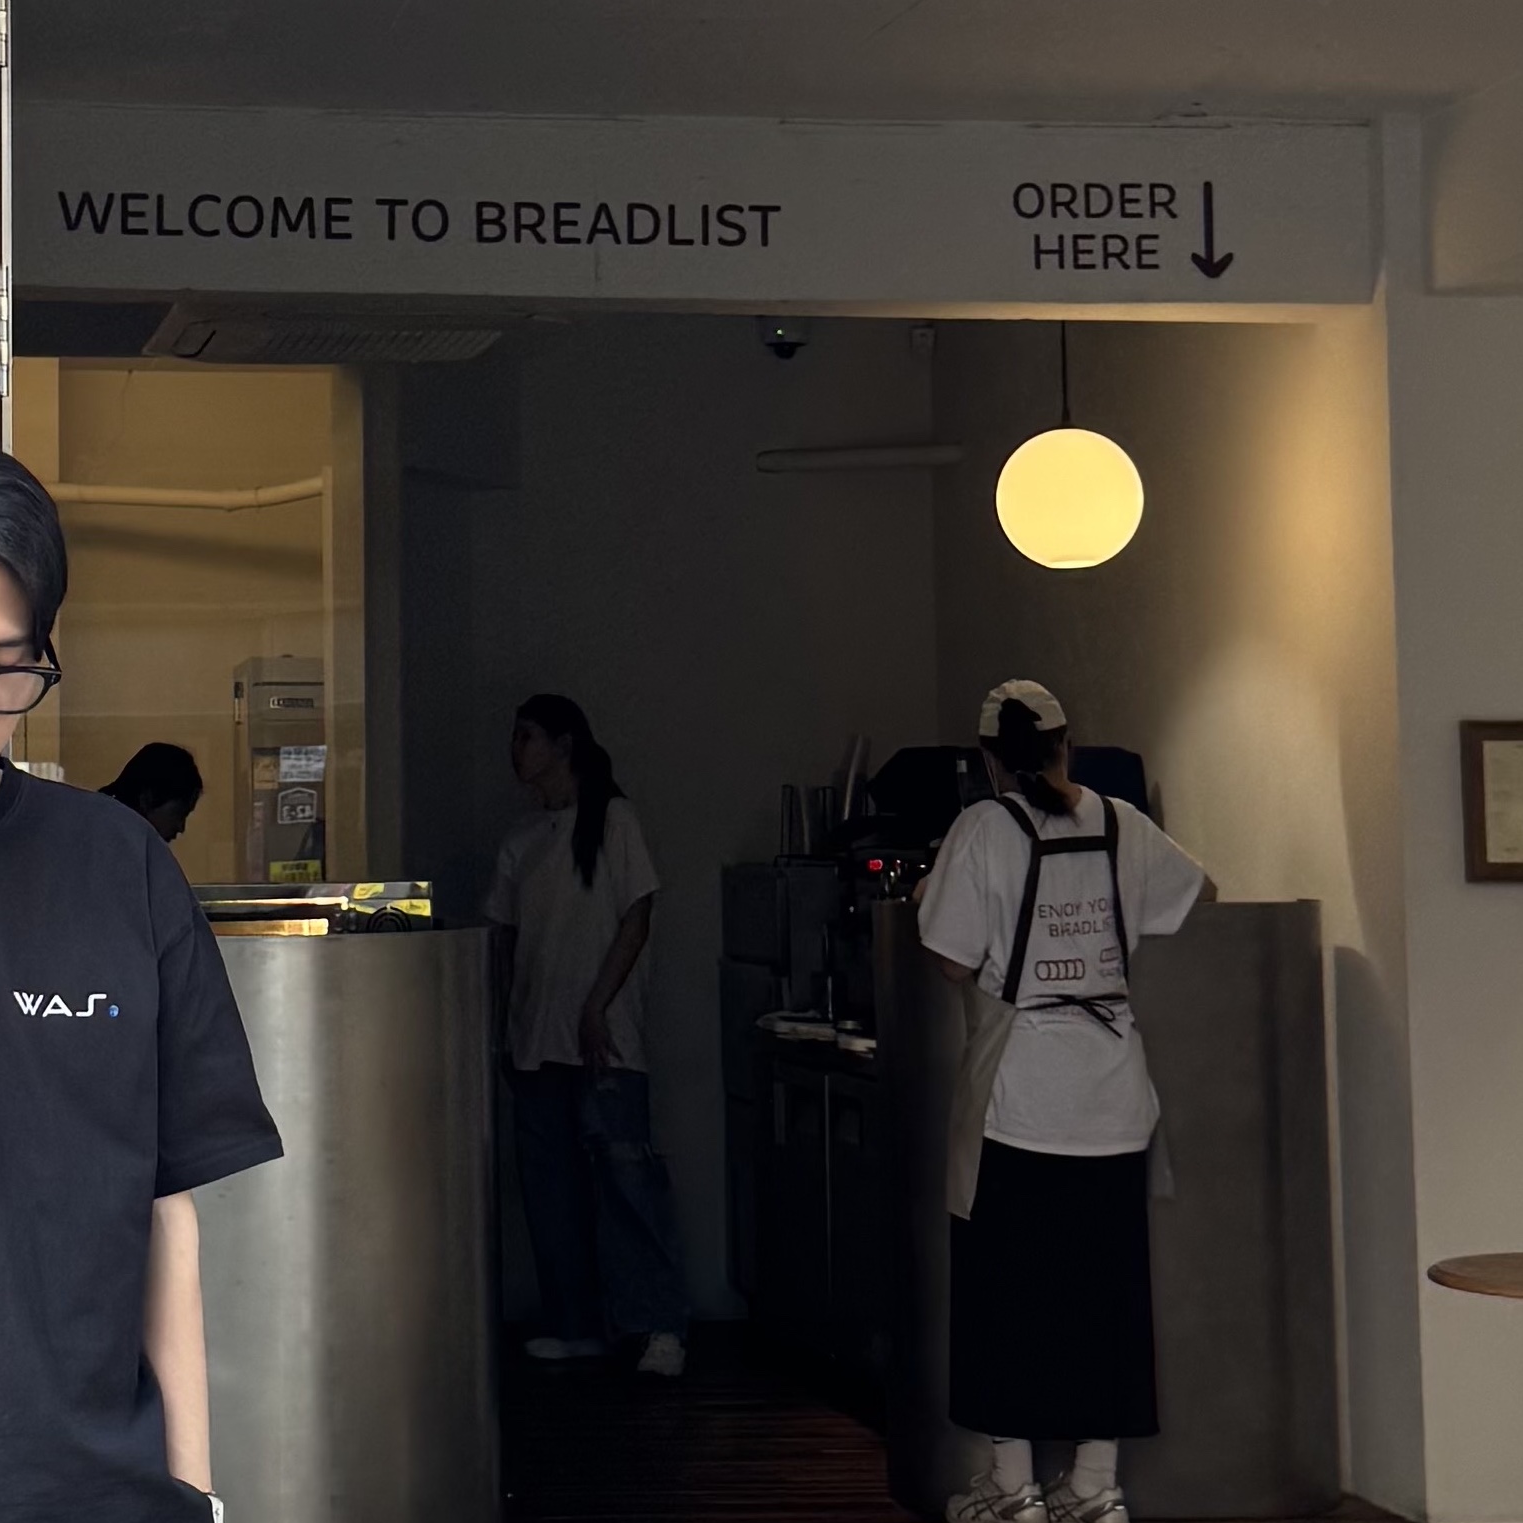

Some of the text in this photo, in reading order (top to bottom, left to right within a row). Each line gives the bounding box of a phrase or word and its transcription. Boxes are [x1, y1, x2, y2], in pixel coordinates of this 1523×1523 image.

[57, 190, 782, 247] WELCOME TO BREADLIST
[1012, 182, 1179, 219] ORDER
[1033, 233, 1160, 270] HERE
